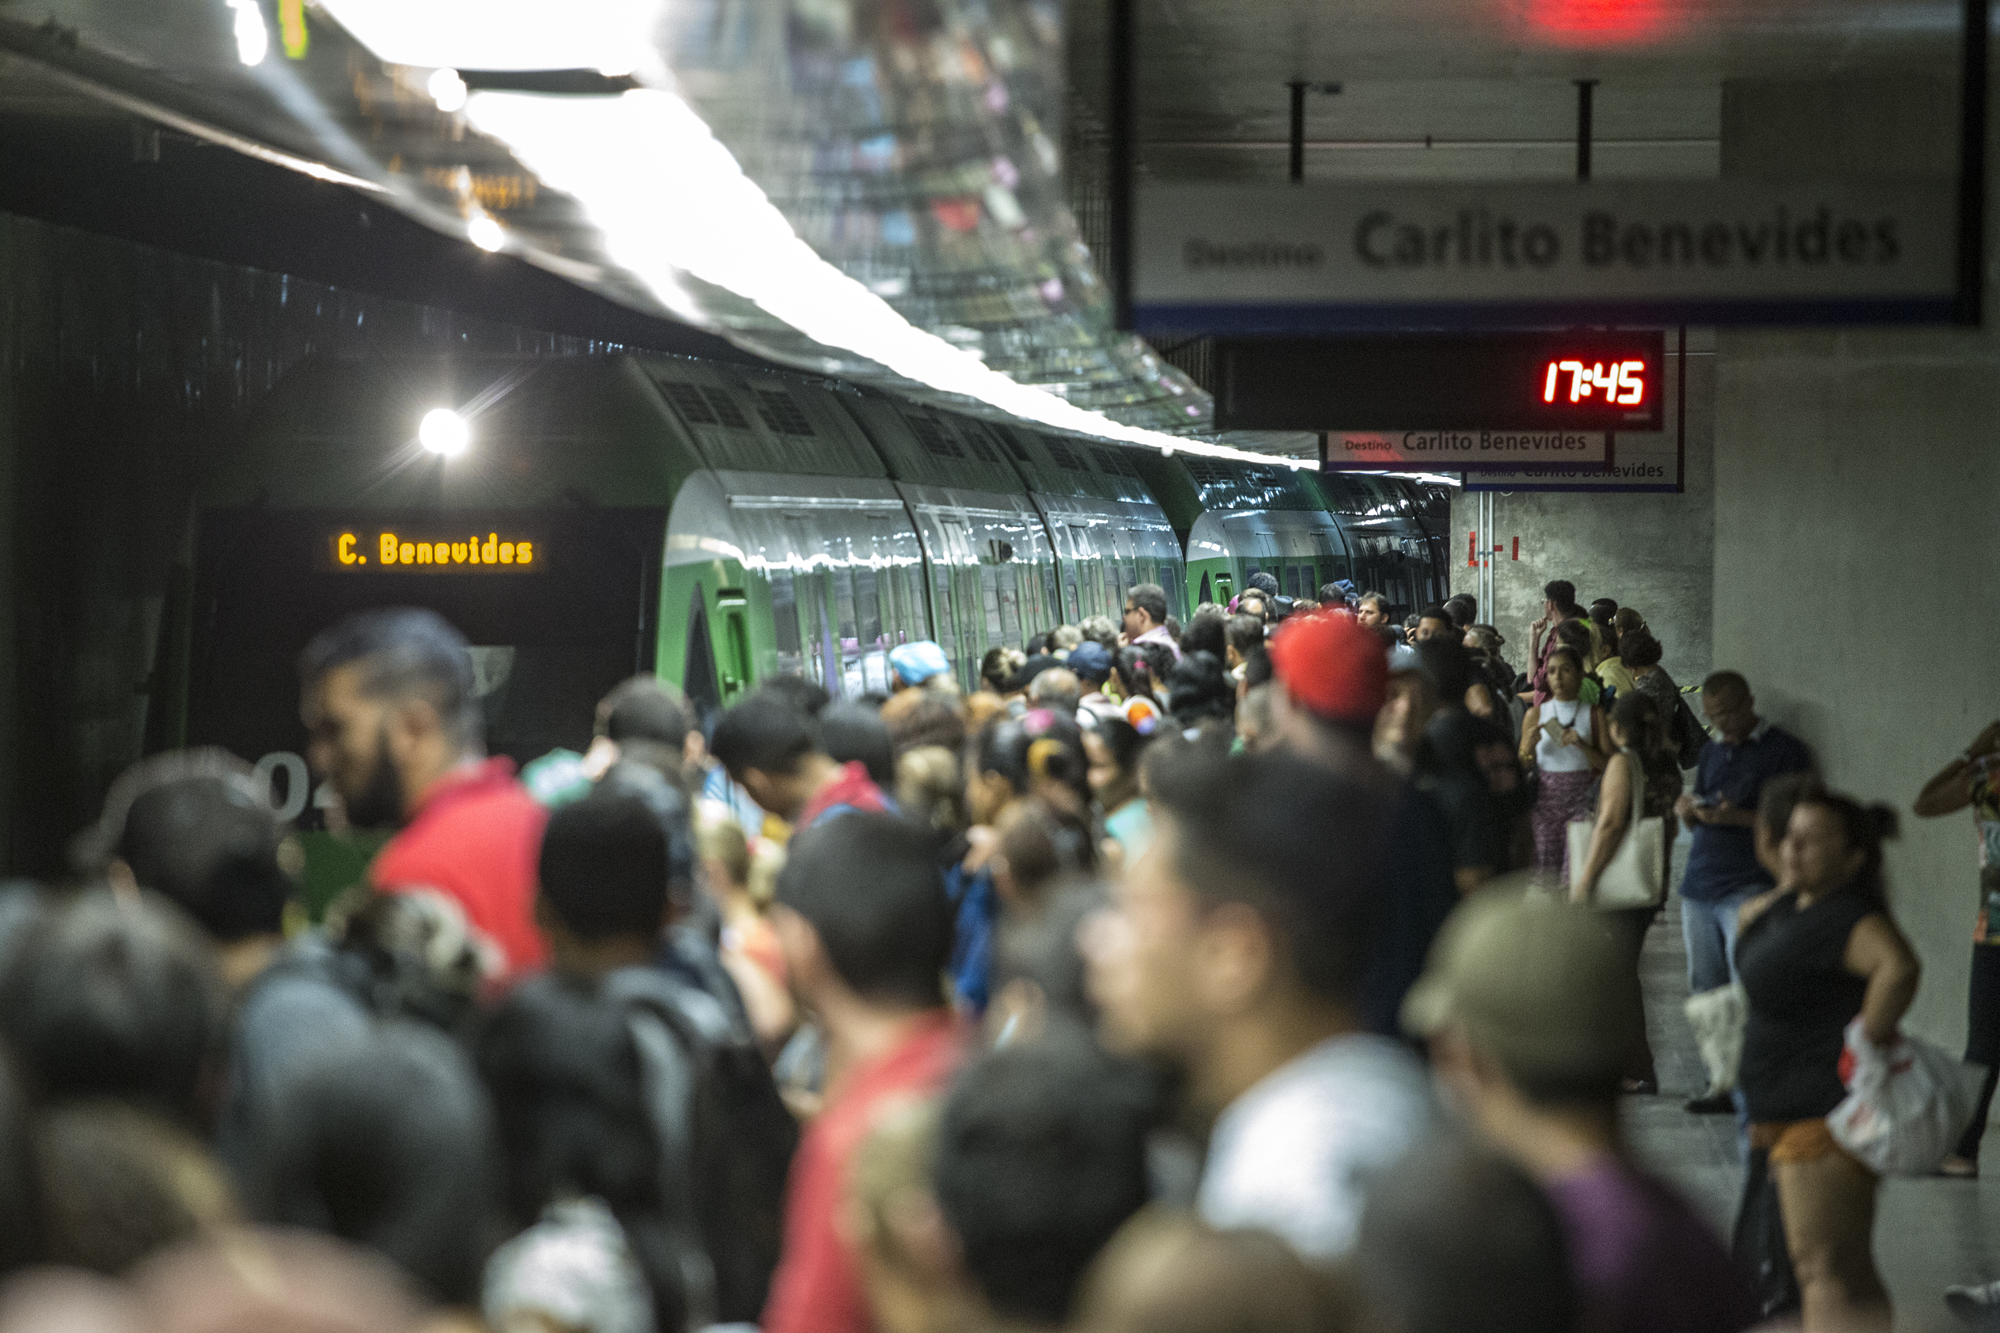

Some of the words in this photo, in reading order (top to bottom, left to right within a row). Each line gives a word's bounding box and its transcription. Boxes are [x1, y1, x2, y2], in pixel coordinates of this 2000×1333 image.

[1352, 208, 1560, 269] Carlito
[1580, 206, 1899, 268] Benevides
[1544, 361, 1644, 404] 17:45
[1345, 439, 1392, 451] Destino
[1403, 431, 1472, 450] Carlito
[1480, 431, 1586, 450] Benevides
[338, 533, 367, 565] C.
[380, 533, 533, 565] Benevides
